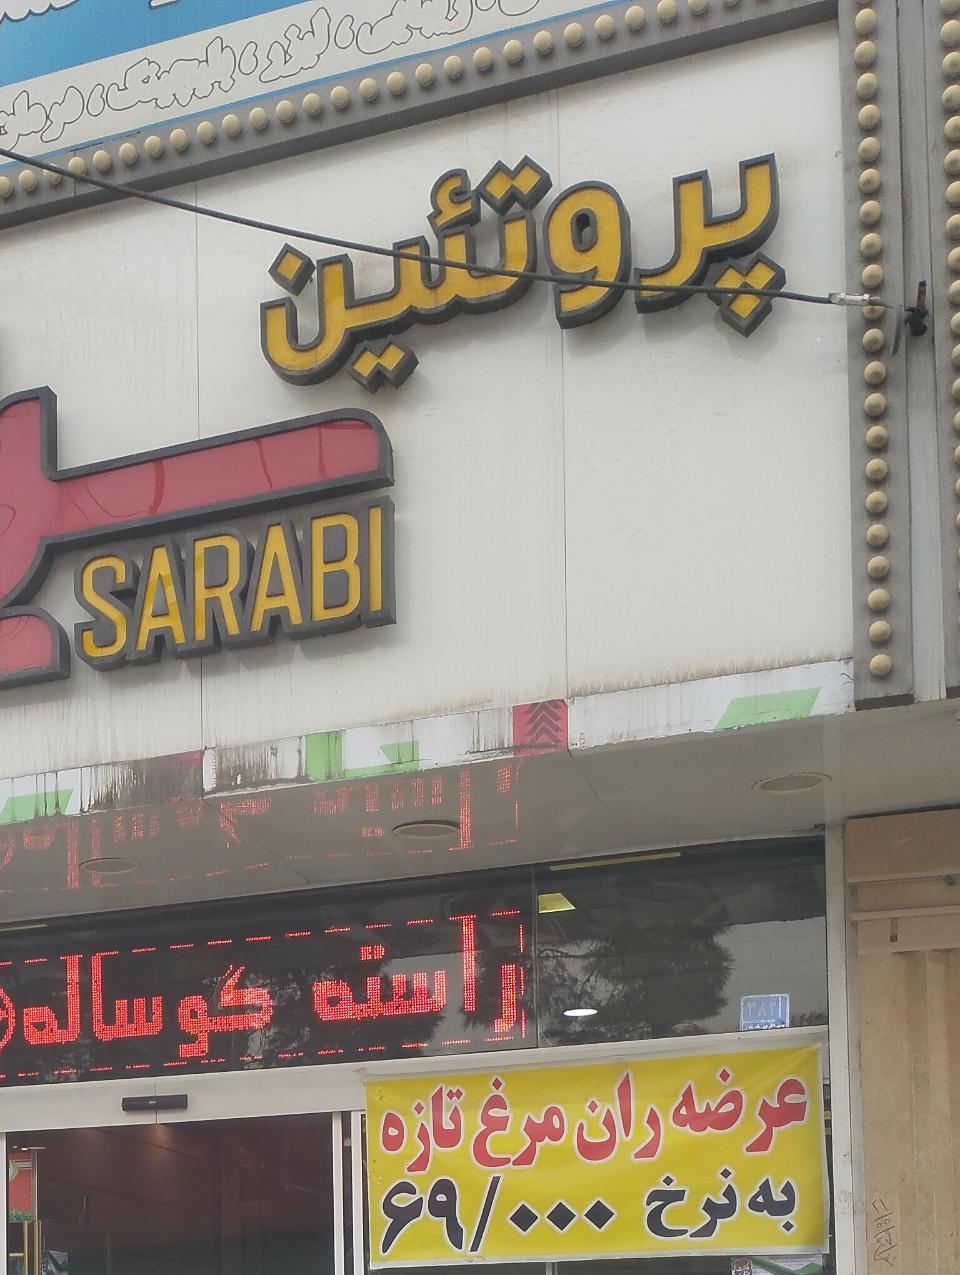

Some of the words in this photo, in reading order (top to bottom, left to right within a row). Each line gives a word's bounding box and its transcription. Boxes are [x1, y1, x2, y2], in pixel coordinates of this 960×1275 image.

[260, 154, 781, 393] پروتئین
[76, 498, 394, 668] SARABI
[380, 1084, 464, 1174] تازه
[471, 1076, 566, 1168] مرغ
[575, 1071, 666, 1162] ران
[671, 1067, 809, 1155] عرضه
[381, 1174, 617, 1254] ۶۹/۰۰۰
[644, 1167, 741, 1240] نرخ
[745, 1174, 799, 1234] به
